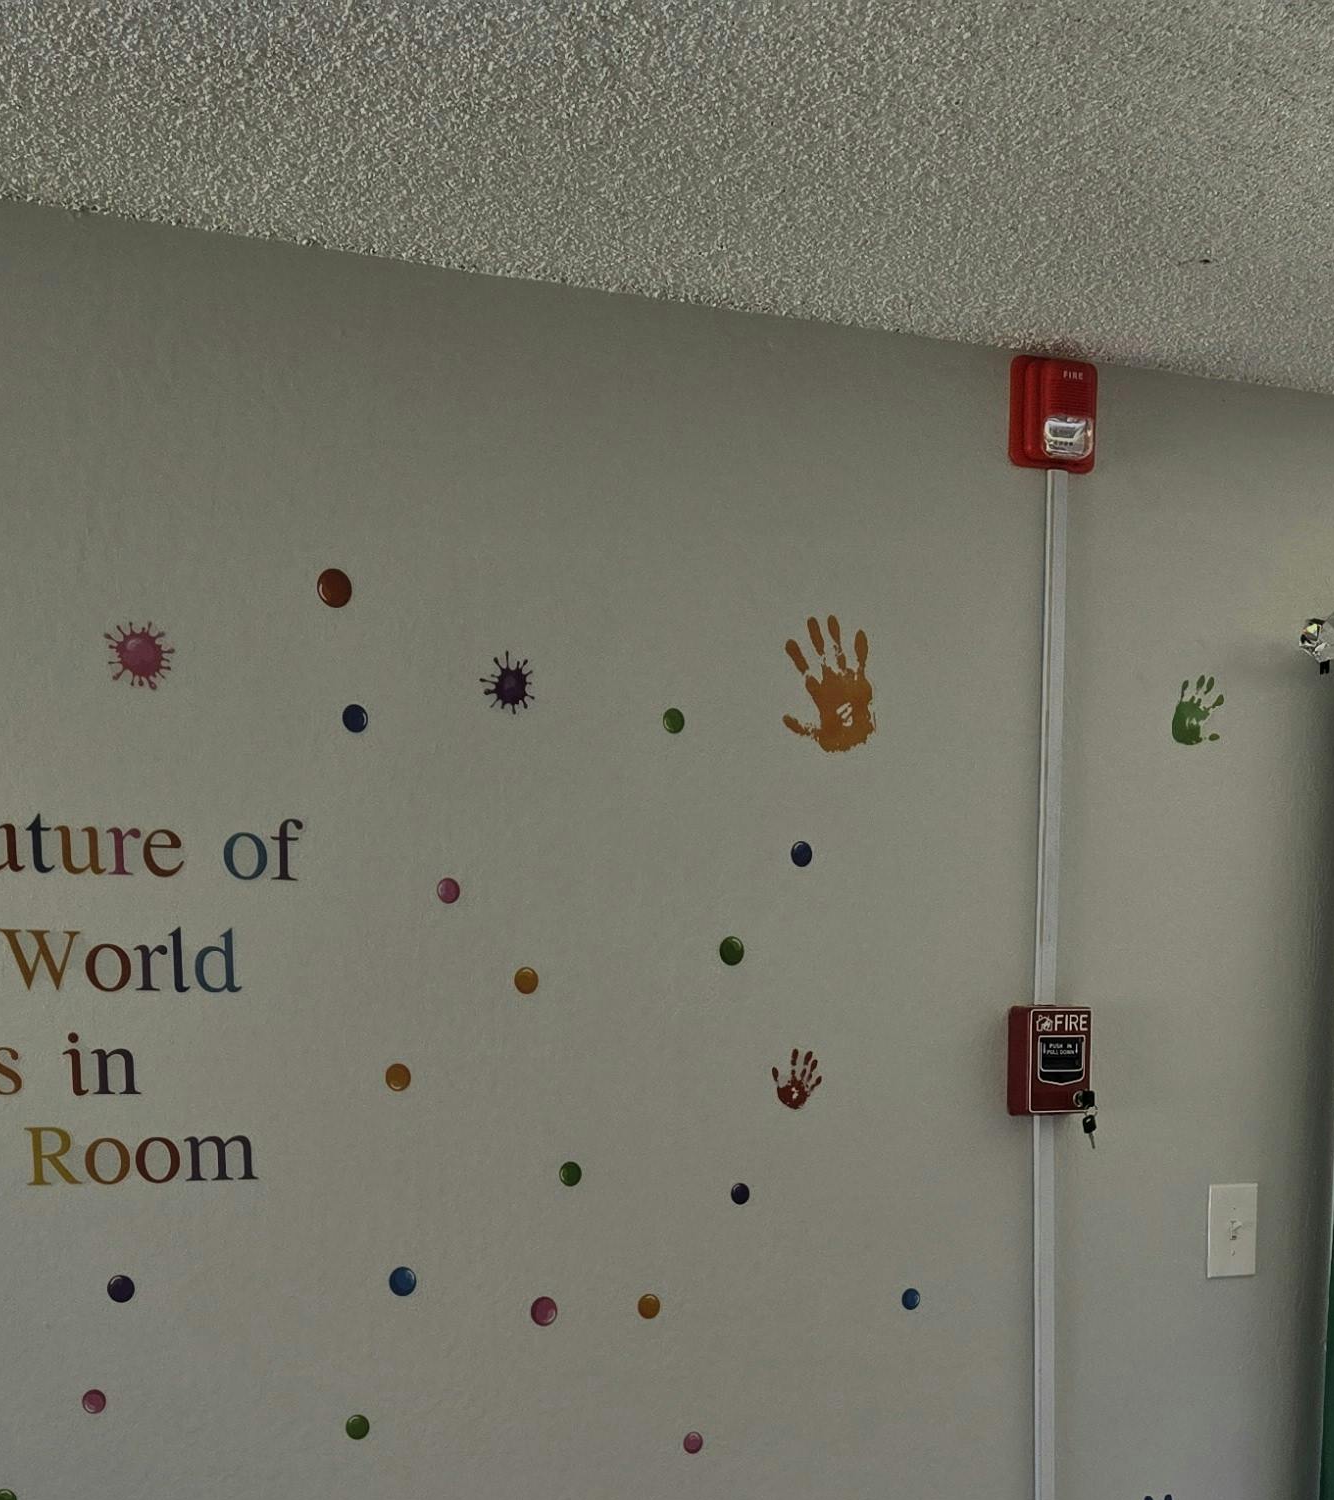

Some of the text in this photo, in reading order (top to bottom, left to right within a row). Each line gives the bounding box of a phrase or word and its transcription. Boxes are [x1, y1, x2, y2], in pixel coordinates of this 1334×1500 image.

[1063, 371, 1084, 380] FIRE
[222, 818, 304, 881] of
[0, 927, 243, 993] World
[1054, 1014, 1089, 1031] FIRE
[64, 1032, 142, 1097] in
[24, 1125, 259, 1187] Room
